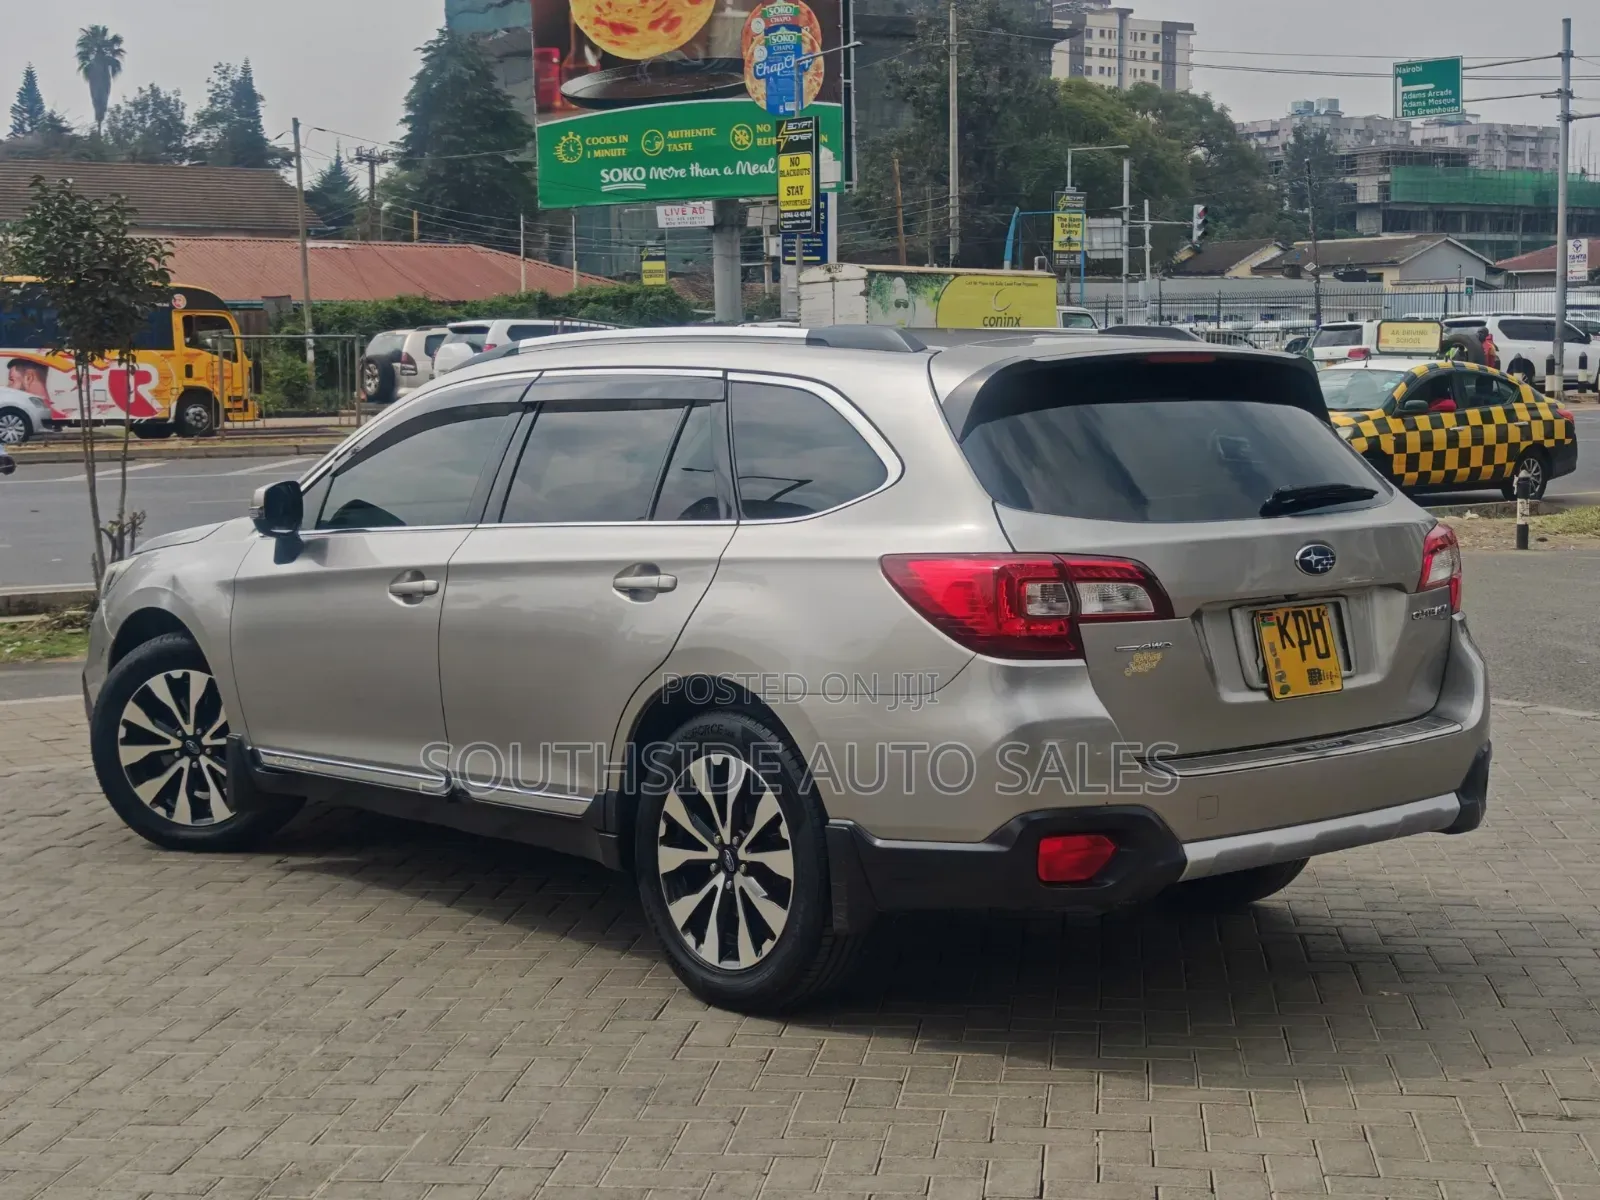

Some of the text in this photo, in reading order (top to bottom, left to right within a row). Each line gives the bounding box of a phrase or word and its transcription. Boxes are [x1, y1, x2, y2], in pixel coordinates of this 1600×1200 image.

[768, 5, 793, 17] SOKO
[771, 34, 795, 44] SOKO
[1396, 65, 1422, 74] Nairobi
[1403, 88, 1452, 100] Adams Arcade
[1428, 97, 1455, 106] Mosque
[1417, 105, 1458, 115] Greenhouse
[756, 124, 771, 133] NO
[786, 120, 813, 130] EGYPT
[667, 127, 717, 139] AUTHENTIC
[586, 134, 628, 145] COOKS IN
[667, 142, 693, 152] TASTE
[593, 148, 627, 158] MINUTE
[790, 156, 800, 167] NO
[600, 166, 646, 183] SOKO
[689, 162, 721, 178] than
[723, 166, 735, 175] a
[735, 157, 777, 176] Meal
[780, 167, 811, 177] BLACKOUTS
[786, 185, 804, 197] STAY
[664, 206, 705, 216] LIVE AD
[982, 312, 1021, 327] coninx
